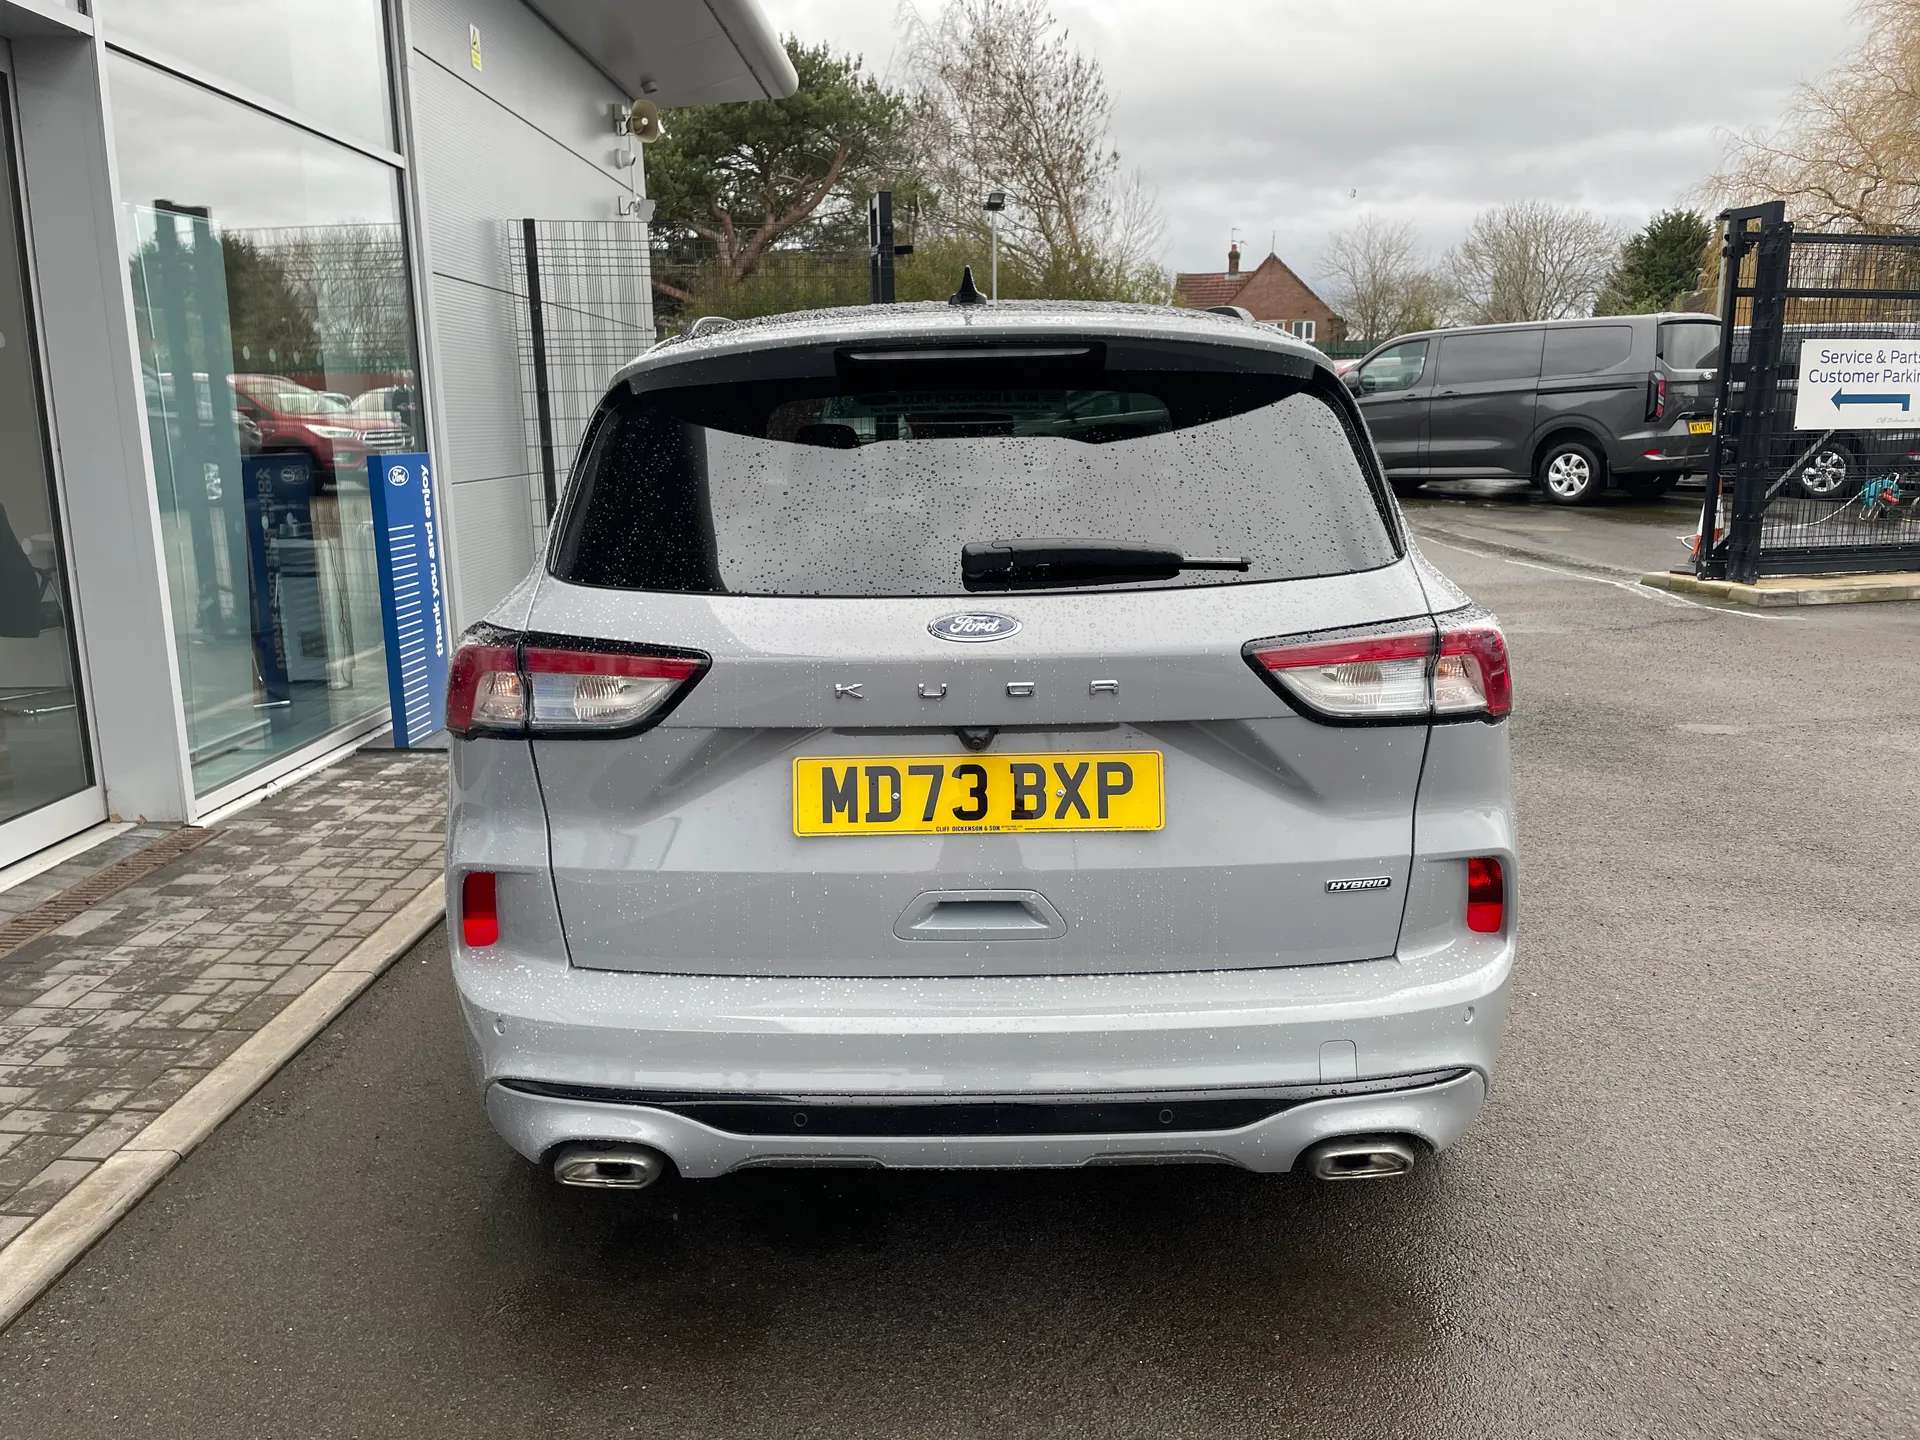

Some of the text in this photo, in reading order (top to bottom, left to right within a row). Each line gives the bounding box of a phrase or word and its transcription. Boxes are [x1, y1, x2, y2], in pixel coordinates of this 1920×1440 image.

[1820, 349, 1920, 364] Service & Part
[1808, 369, 1880, 383] Customer
[420, 464, 444, 657] thank you and enjoy
[949, 615, 1000, 633] Ford
[821, 762, 1134, 824] MD73 BXP
[1329, 879, 1389, 890] HYBRID
